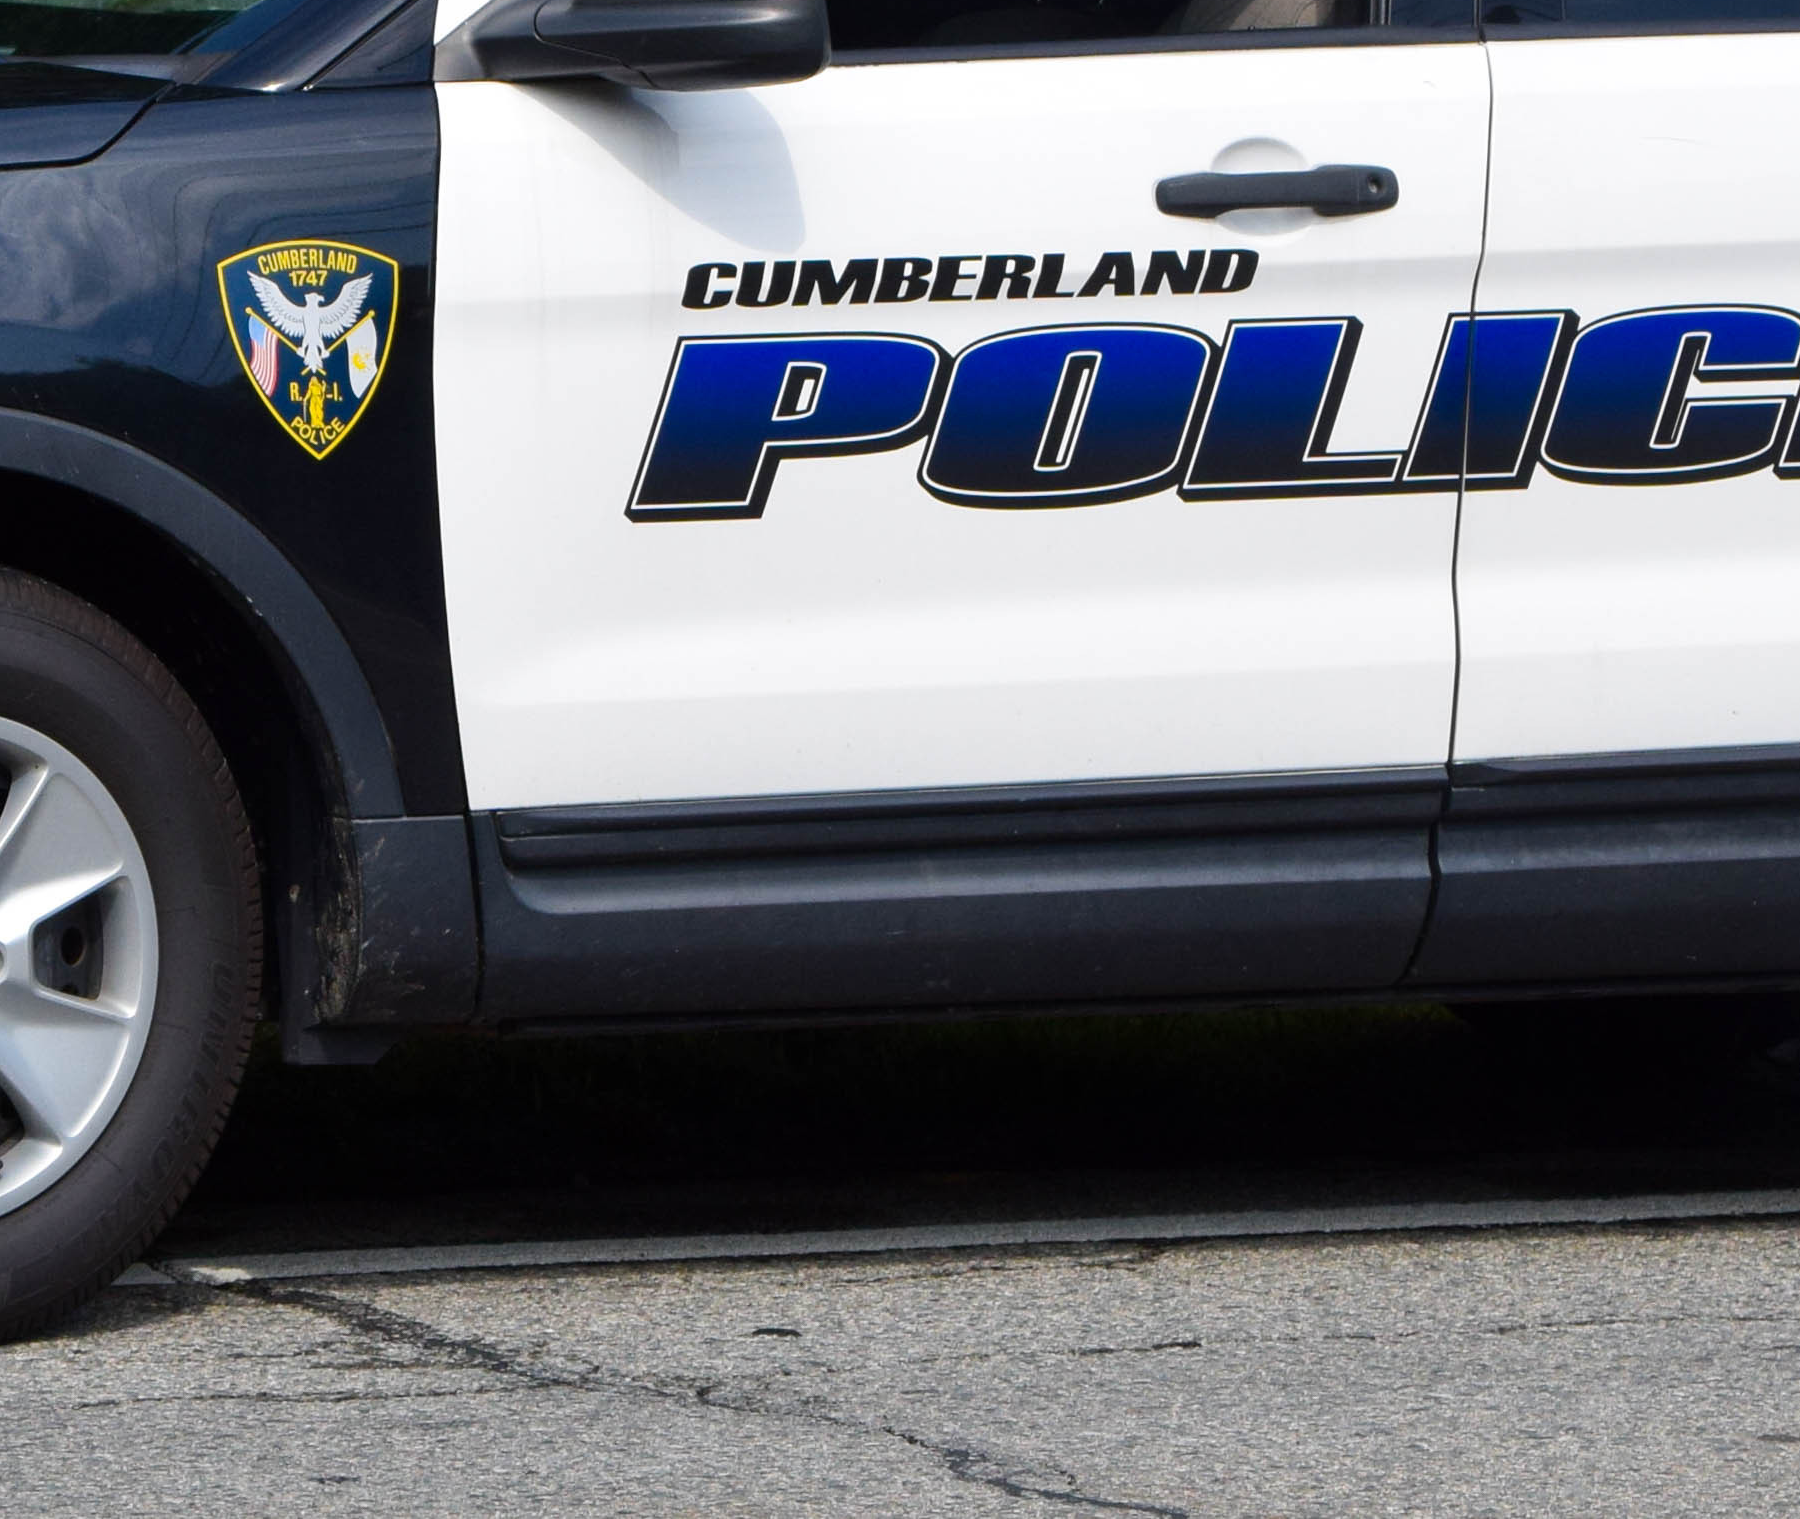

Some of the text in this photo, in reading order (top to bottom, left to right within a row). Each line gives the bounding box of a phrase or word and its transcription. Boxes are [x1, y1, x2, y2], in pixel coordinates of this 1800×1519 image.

[257, 248, 357, 274] CUMBERLAND
[289, 270, 328, 287] 1747
[681, 249, 1260, 310] CUMBERLAND
[290, 416, 346, 445] POLICE
